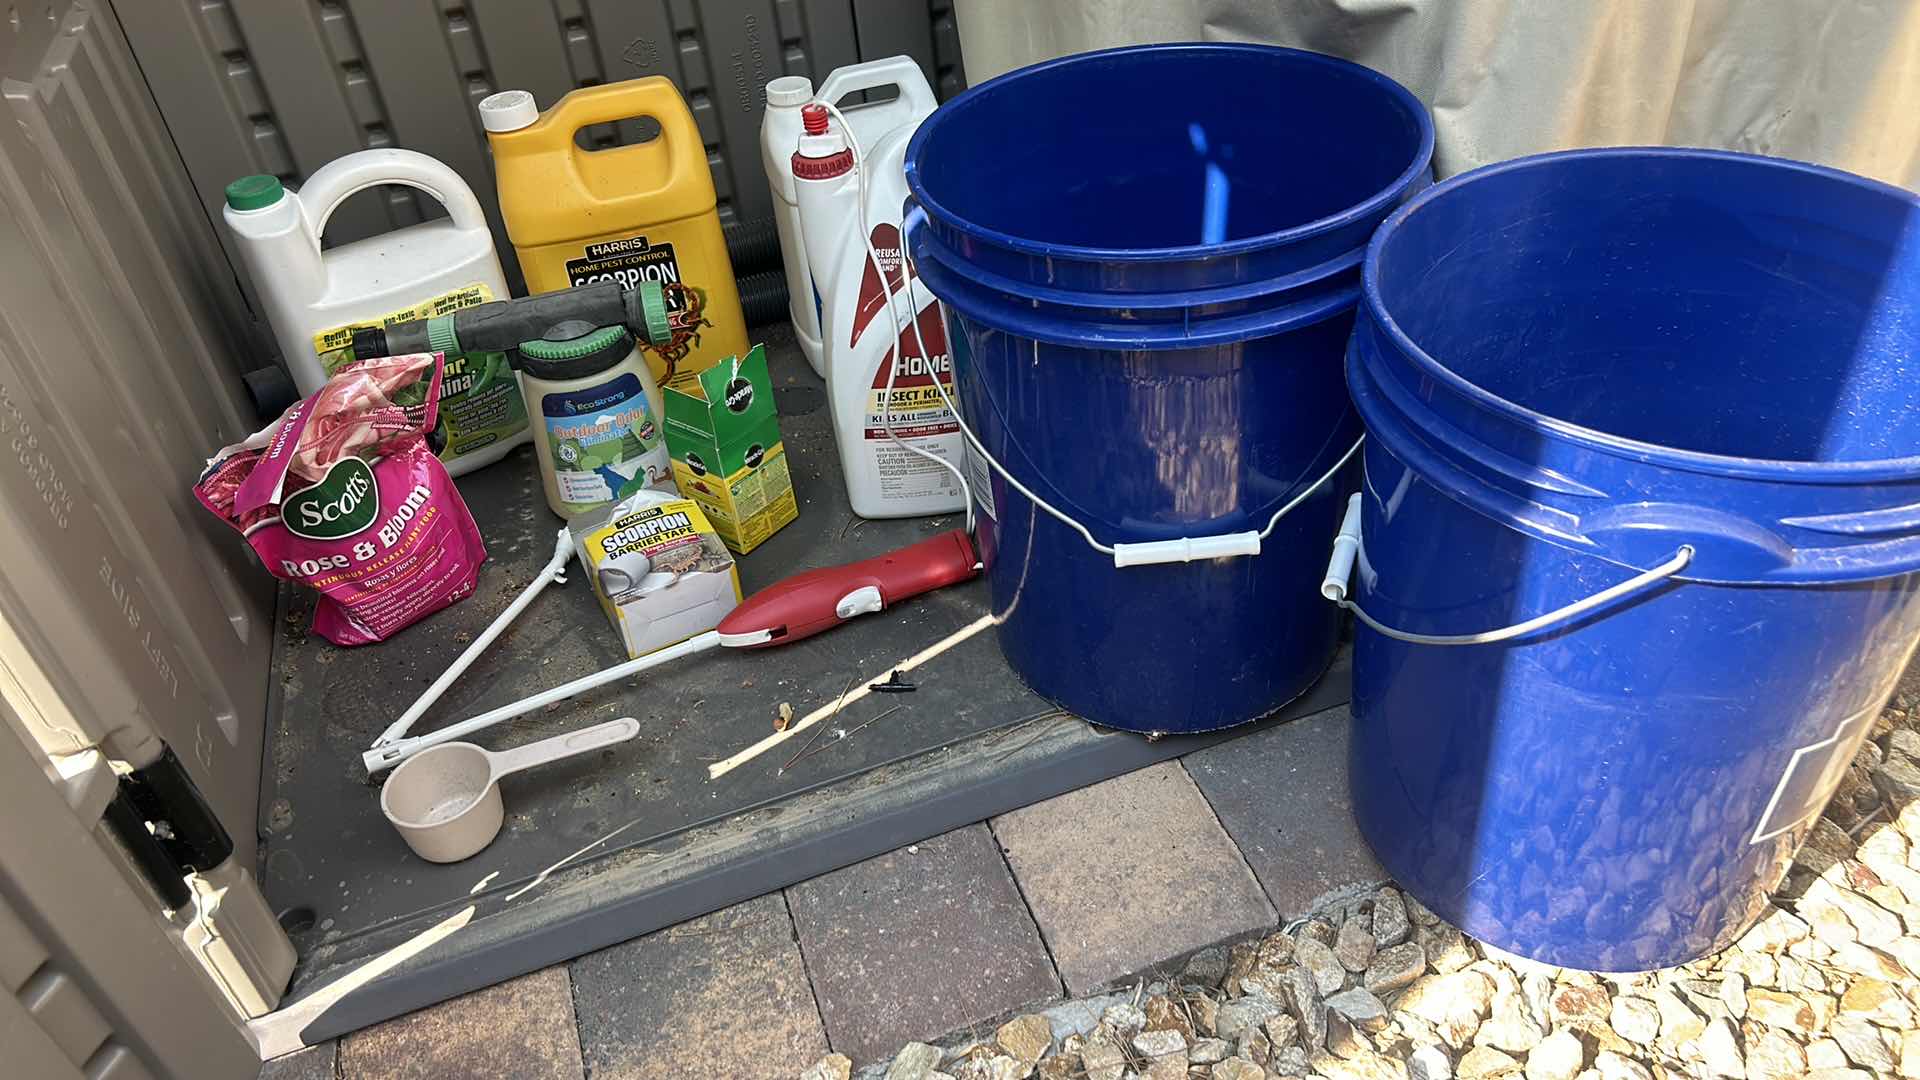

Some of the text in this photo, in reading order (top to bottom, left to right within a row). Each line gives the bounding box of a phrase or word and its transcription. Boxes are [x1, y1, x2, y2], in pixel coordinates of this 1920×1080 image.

[591, 238, 642, 256] HARRIS
[875, 248, 901, 258] REUSA
[570, 263, 600, 275] HOME
[601, 259, 623, 269] PEST
[625, 251, 671, 265] CONTROL
[879, 257, 902, 265] OMFOR
[464, 296, 483, 307] Patio
[323, 330, 348, 343] Refill
[895, 354, 950, 377] HOME
[577, 392, 625, 411] EcoStrong
[872, 413, 897, 423] KILS
[900, 413, 916, 421] ALL
[553, 422, 610, 438] Outdoor
[300, 469, 369, 529] Scotts
[618, 508, 658, 527] HARRIS
[282, 552, 352, 578] Rose
[353, 541, 377, 562] &
[377, 484, 433, 549] Bloom
[601, 512, 691, 553] SCORPION
[313, 569, 363, 588] NTINUOUS
[366, 548, 405, 573] RELEASE
[404, 526, 422, 550] PLANT
[420, 506, 438, 527] FOOD
[608, 534, 664, 561] BARRIER
[662, 526, 696, 540] TAPE
[364, 569, 390, 588] Rosas
[396, 555, 418, 573] flores
